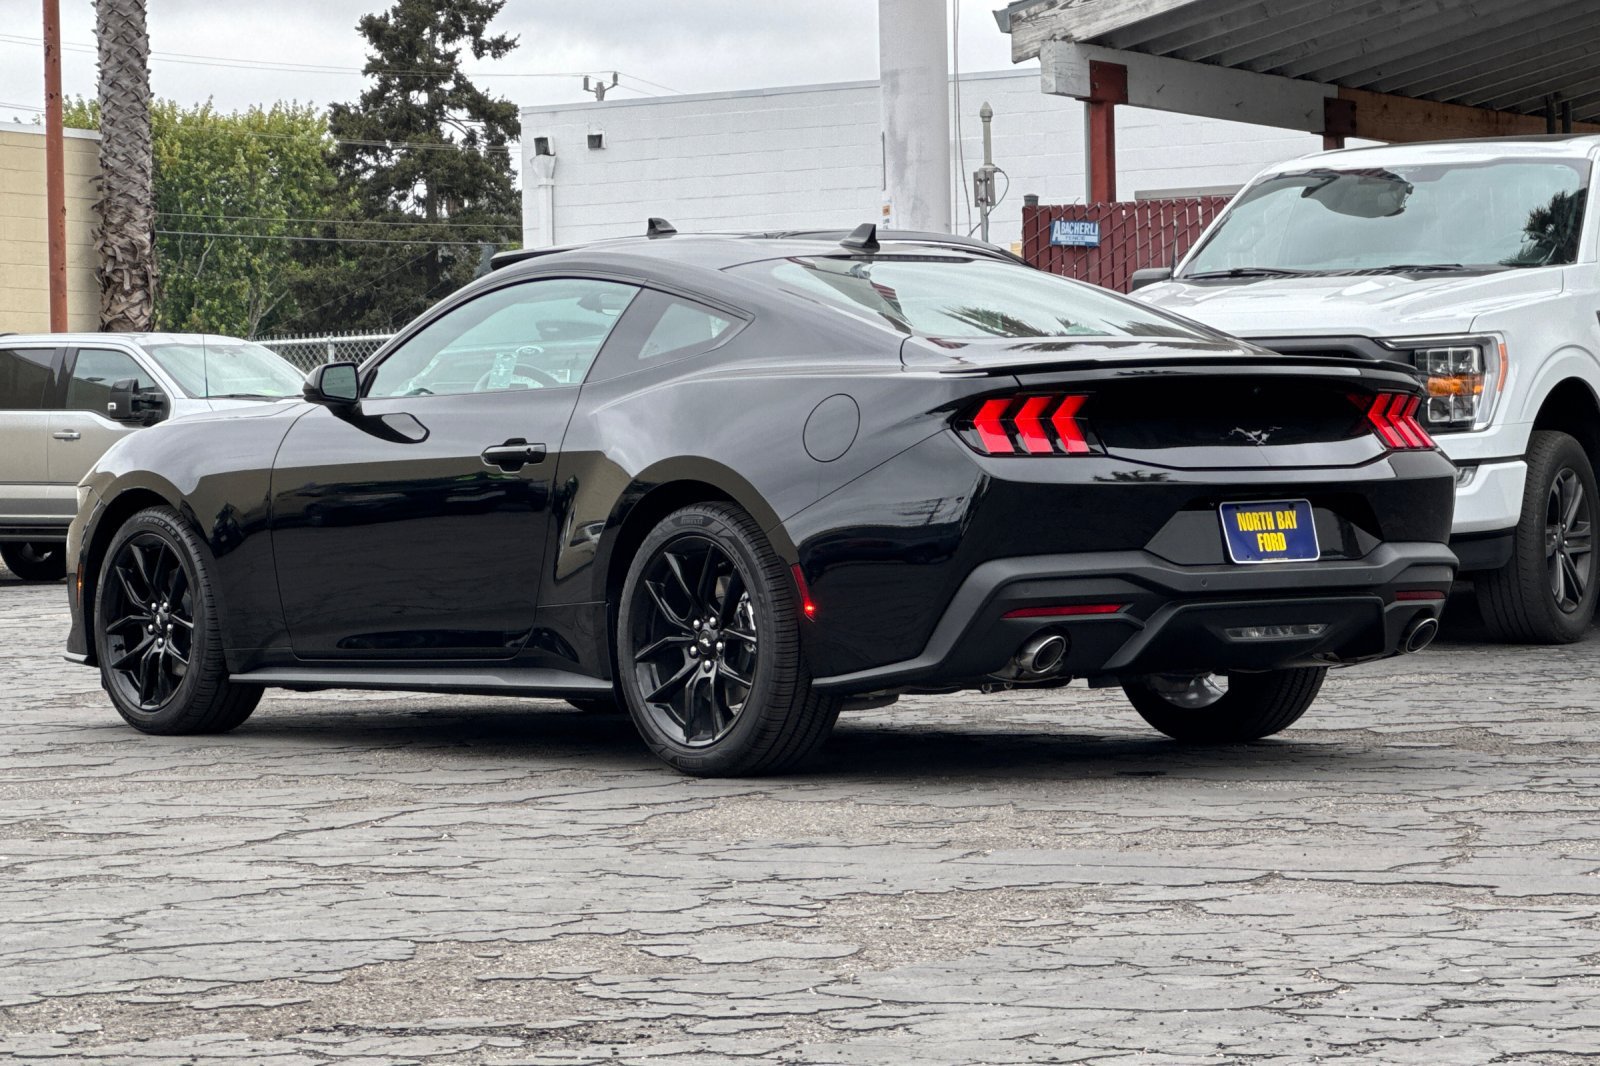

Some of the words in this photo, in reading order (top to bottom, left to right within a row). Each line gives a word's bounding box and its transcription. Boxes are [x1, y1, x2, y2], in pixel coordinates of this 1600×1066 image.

[1052, 220, 1098, 241] ABACHERLI
[1236, 511, 1275, 531] NORTH
[1275, 510, 1297, 529] BAY
[1256, 532, 1287, 552] FORD
